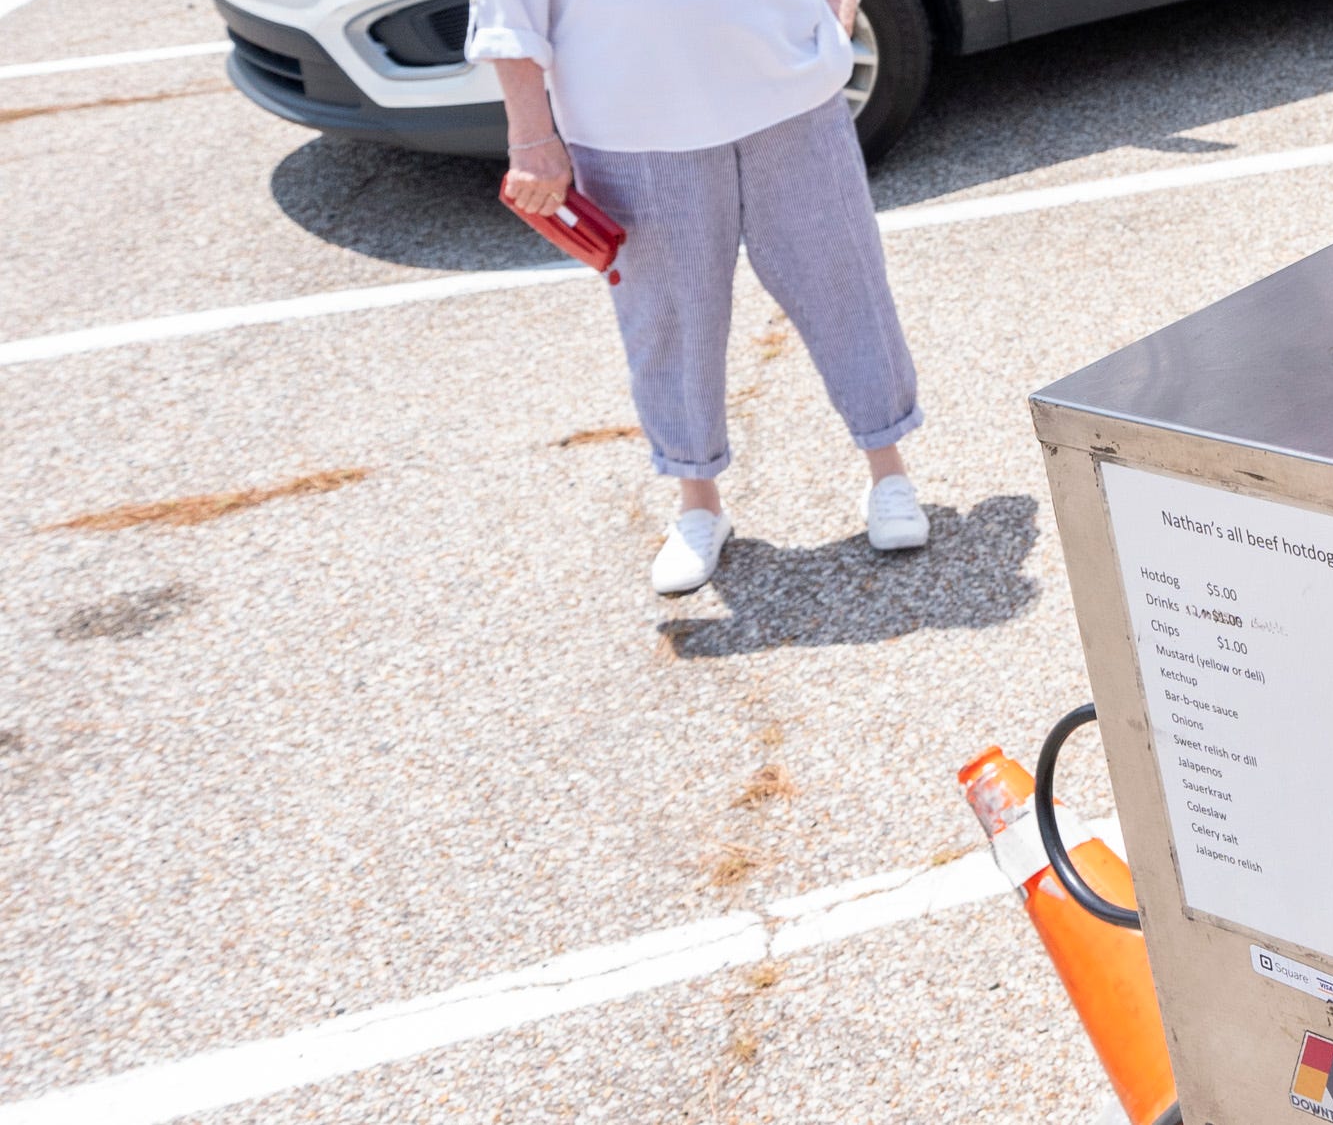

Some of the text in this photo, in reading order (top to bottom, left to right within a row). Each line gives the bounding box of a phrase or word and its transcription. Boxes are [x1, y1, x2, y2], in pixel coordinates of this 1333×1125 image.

[1161, 510, 1224, 539] Nathan's
[1227, 527, 1244, 544] all
[1246, 529, 1279, 552] beef
[1140, 566, 1238, 602] Hotdog $5.00
[1145, 593, 1180, 613] Drinks
[1151, 619, 1248, 655] Chips $1.00
[1155, 644, 1266, 684] Mustard (yellow or deli)
[1160, 667, 1198, 687] Ketchup
[1164, 689, 1239, 719] Bar-b-que sauce
[1171, 713, 1204, 731] Onions
[1173, 734, 1258, 767] Sweet relish or dill
[1178, 756, 1223, 778] Jalapenos
[1182, 778, 1233, 803] Sauerkraut
[1186, 800, 1227, 821] Coleslaw
[1191, 822, 1239, 845] Celery salt
[1196, 843, 1263, 873] Jalapeno relish
[1274, 962, 1310, 984] Square
[1319, 981, 1333, 992] VISA
